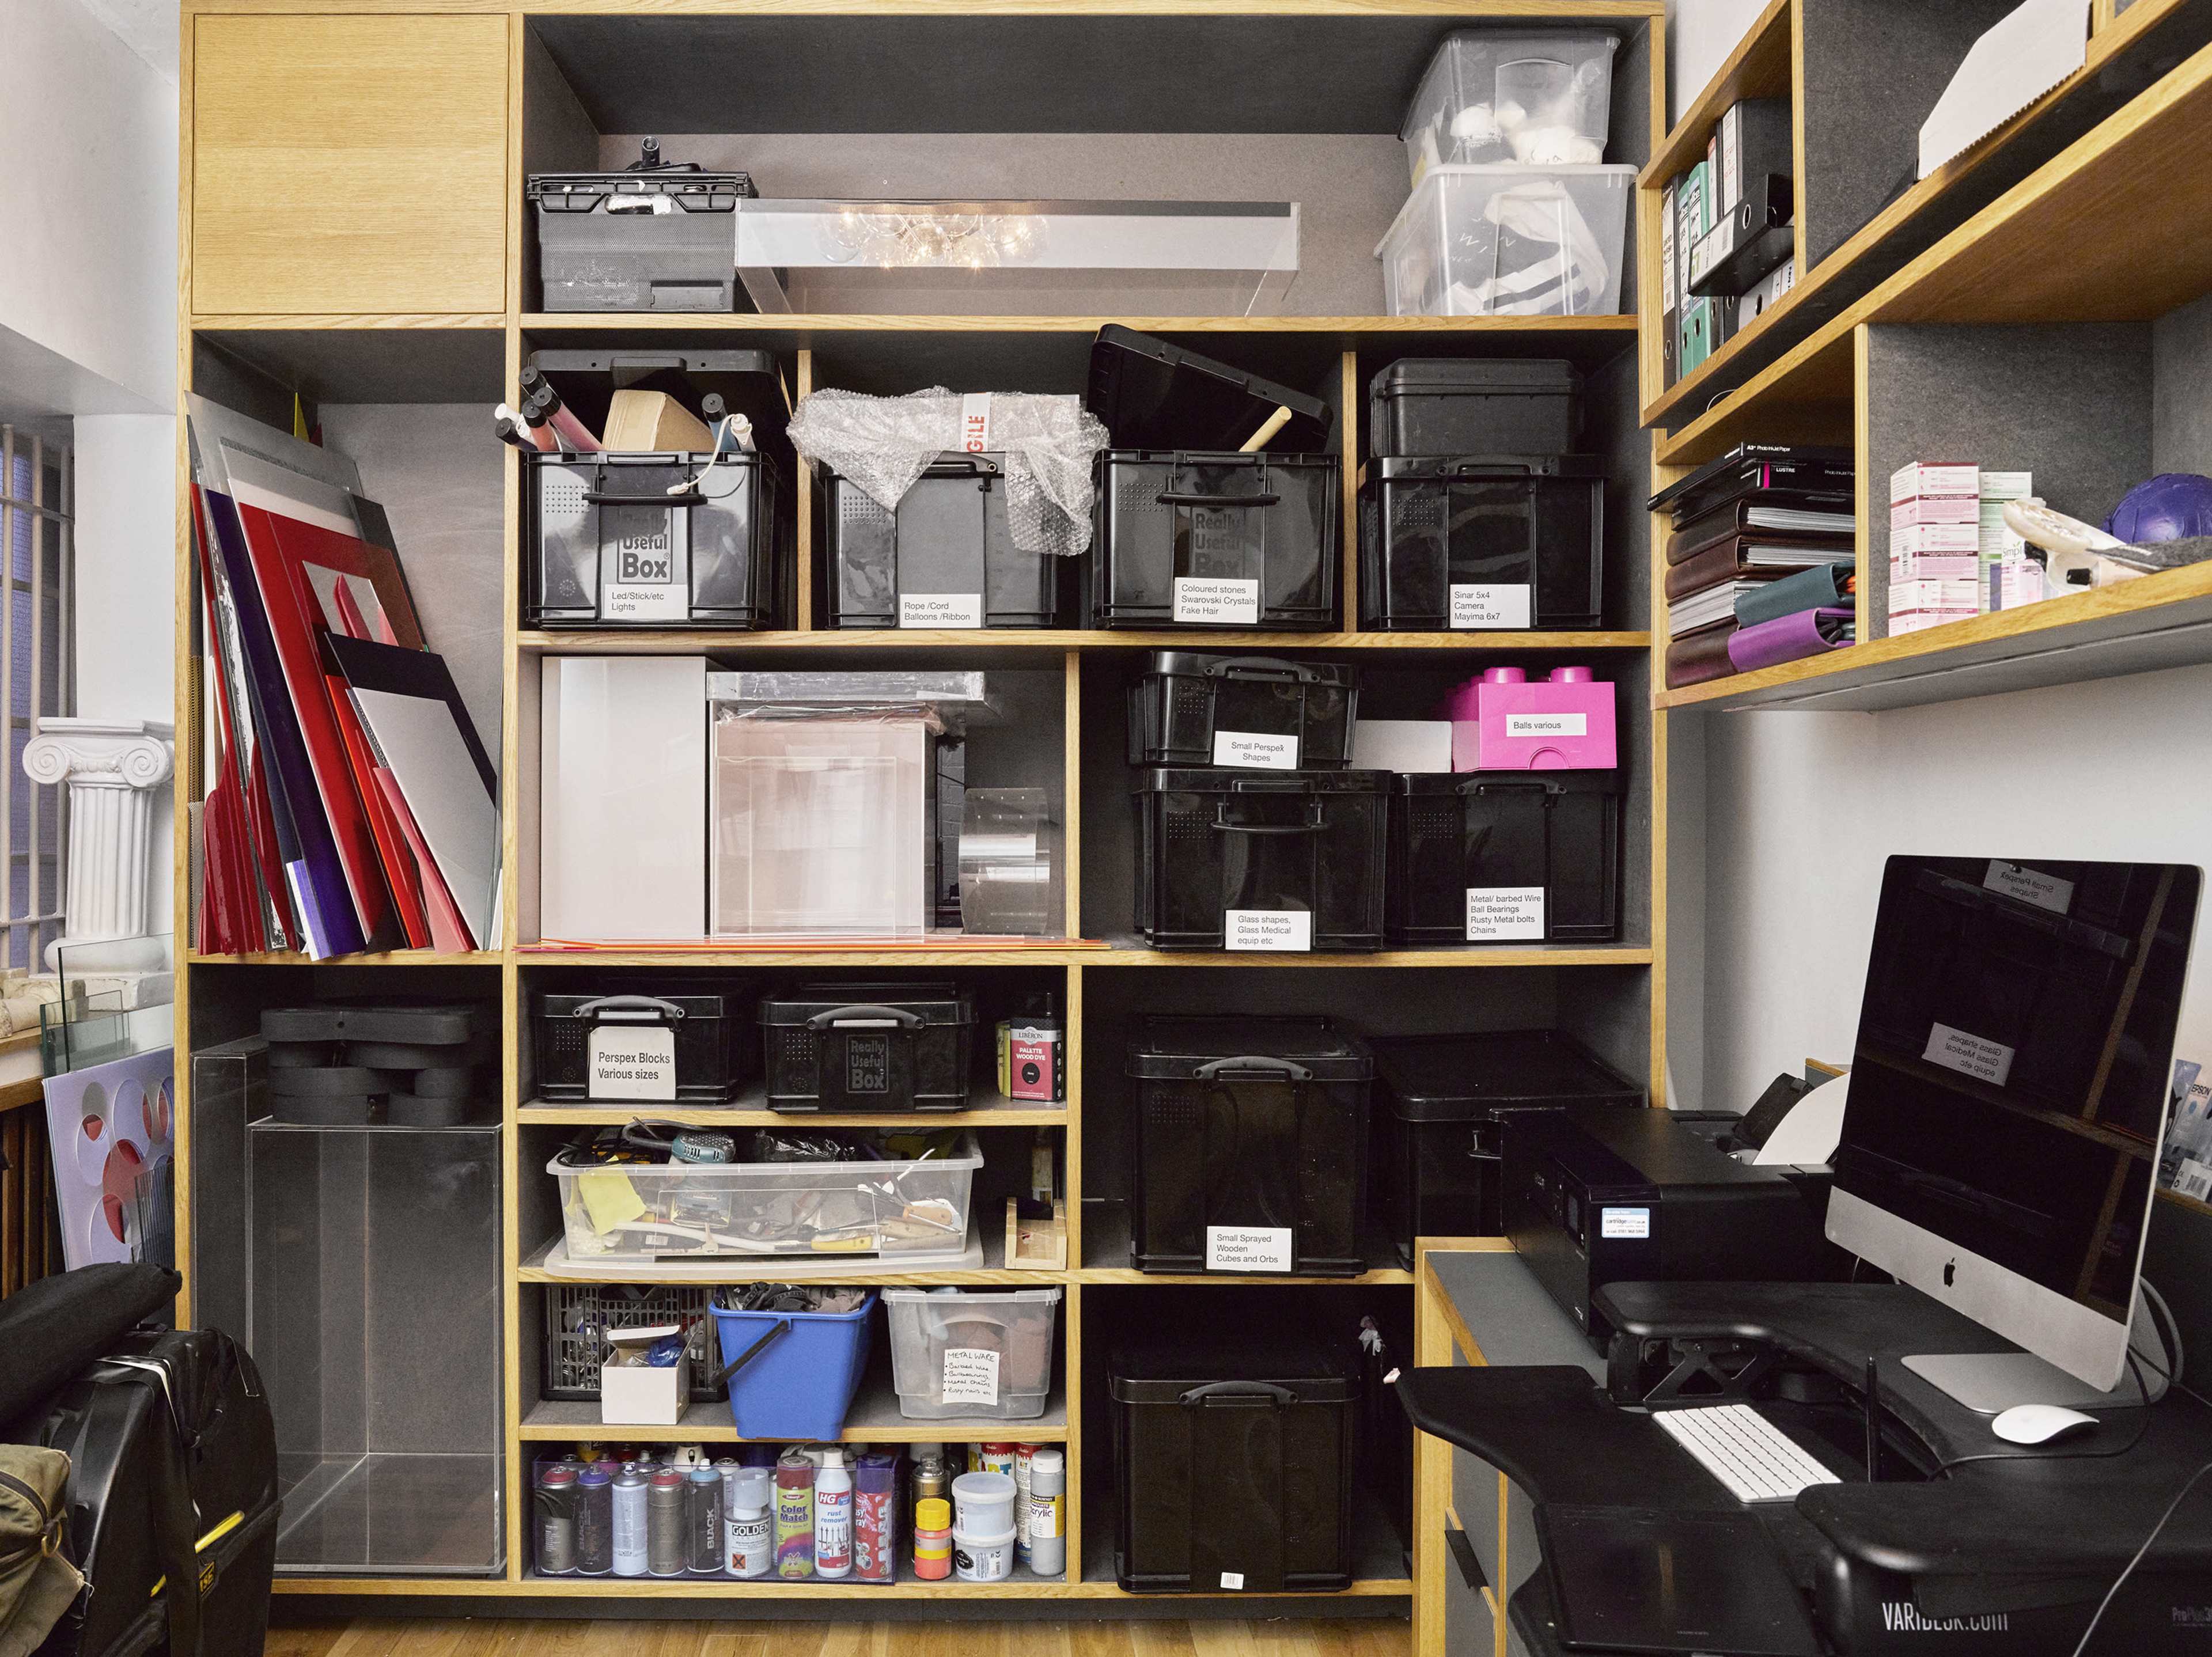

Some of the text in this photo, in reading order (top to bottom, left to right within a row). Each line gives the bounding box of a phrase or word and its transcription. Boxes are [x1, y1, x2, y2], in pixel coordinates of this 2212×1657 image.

[623, 553, 668, 578] Box
[1181, 584, 1246, 594] Coloured stones
[612, 591, 664, 600] Led/Stick/etc
[1455, 591, 1474, 599] Sinar
[1181, 595, 1256, 606] Swarovski Crystals
[612, 603, 636, 612] Lights
[904, 602, 925, 611] Rope
[1181, 606, 1219, 615] Fake Hair
[1455, 613, 1484, 621] Mayima
[1231, 741, 1252, 750] Small
[1243, 753, 1271, 762] Shapes
[1471, 905, 1520, 914] Ball Bearings
[1238, 915, 1291, 924] Glass shapes,
[1471, 916, 1492, 925] Rusty
[1237, 926, 1291, 934] Glass Medical
[1470, 926, 1497, 934] Chains
[1237, 936, 1259, 945] equip
[851, 1040, 885, 1055] Really
[599, 1052, 671, 1065] Perspex Blocks
[851, 1054, 884, 1068] Useful
[598, 1067, 660, 1080] Various sizes
[851, 1068, 885, 1089] Box
[2191, 1083, 2212, 1096] EPSON
[1217, 1234, 1272, 1243] Small Sprayed
[1216, 1254, 1241, 1262] Cubes
[1259, 1255, 1279, 1263] Orbs
[948, 1351, 995, 1362] METAL WARE
[819, 1493, 836, 1504] HG
[781, 1504, 807, 1514] Color
[780, 1513, 808, 1523] Match
[732, 1522, 769, 1536] GOLDEN
